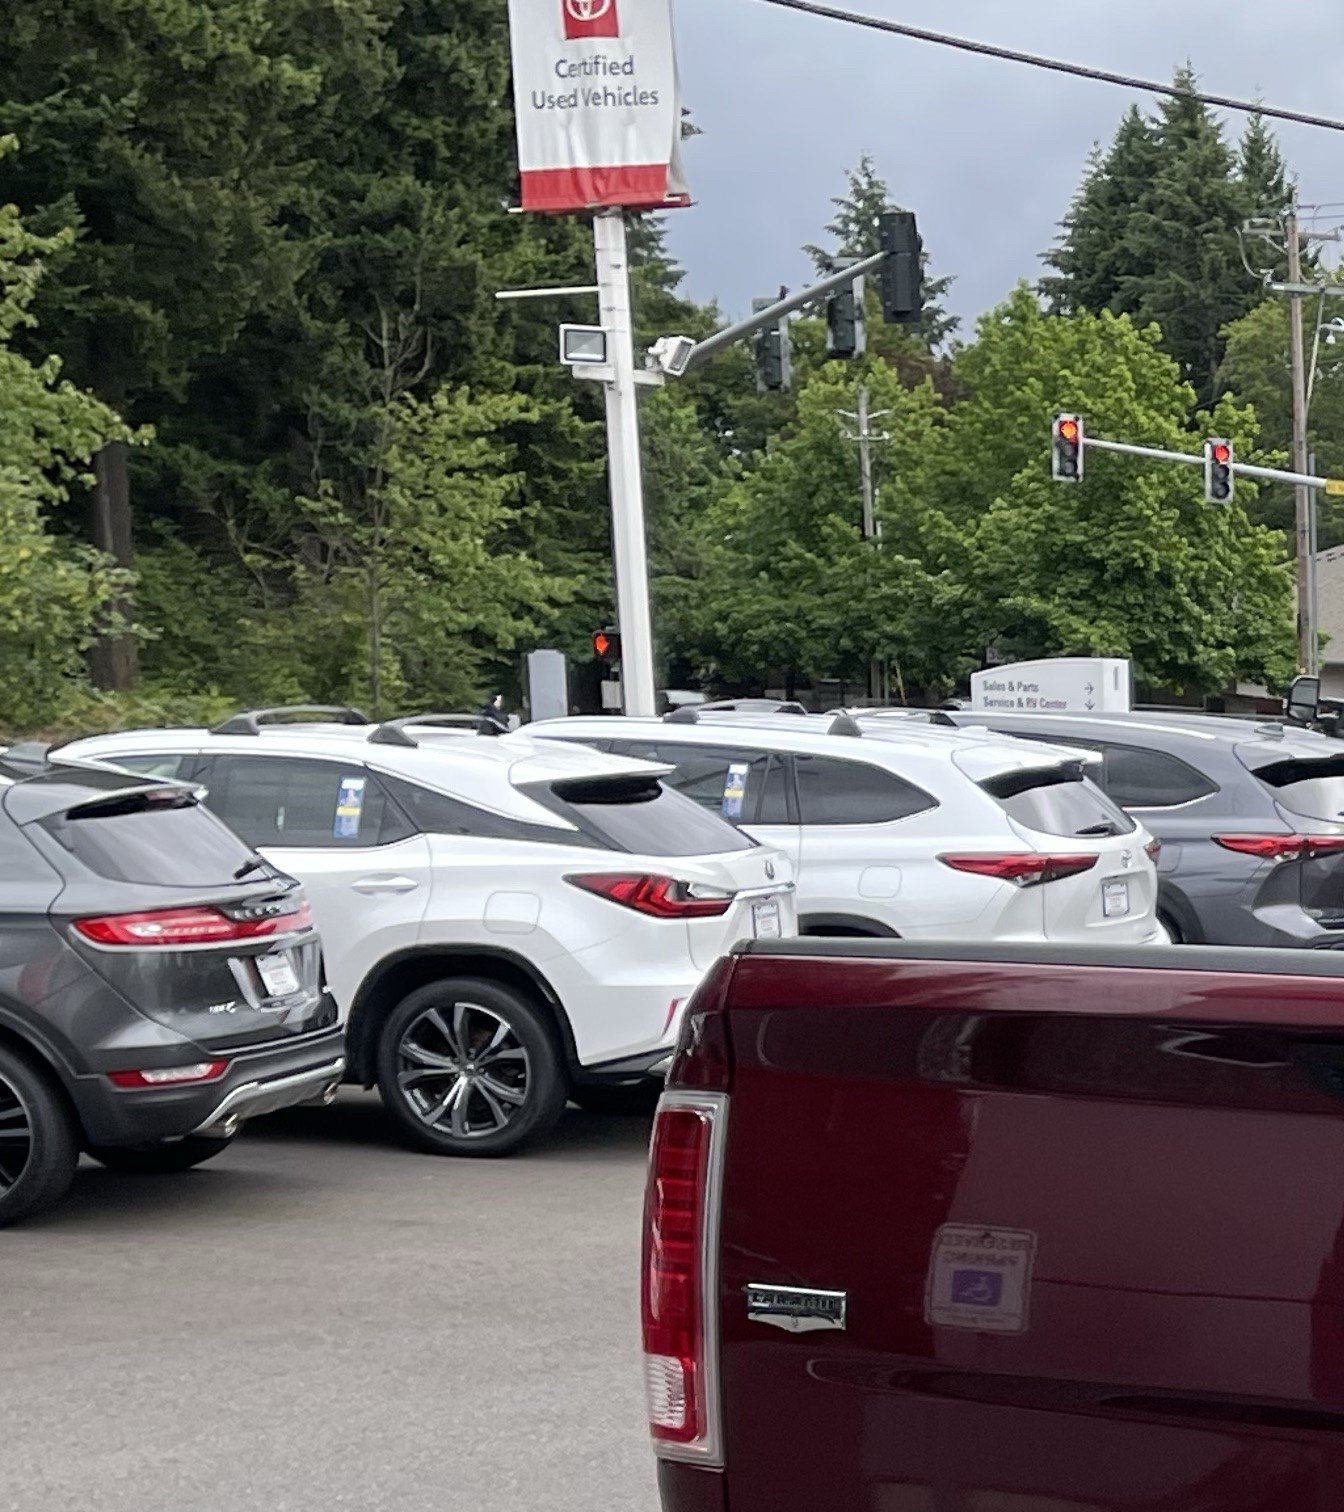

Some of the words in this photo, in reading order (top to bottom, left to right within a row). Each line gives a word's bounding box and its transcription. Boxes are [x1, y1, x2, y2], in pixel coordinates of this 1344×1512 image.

[555, 54, 634, 78] Certified
[531, 87, 578, 109] Used
[580, 84, 659, 106] Vehicles
[983, 681, 1006, 691] Sales
[1008, 681, 1015, 692] &
[1017, 681, 1040, 692] Parts
[983, 696, 1015, 708] Service
